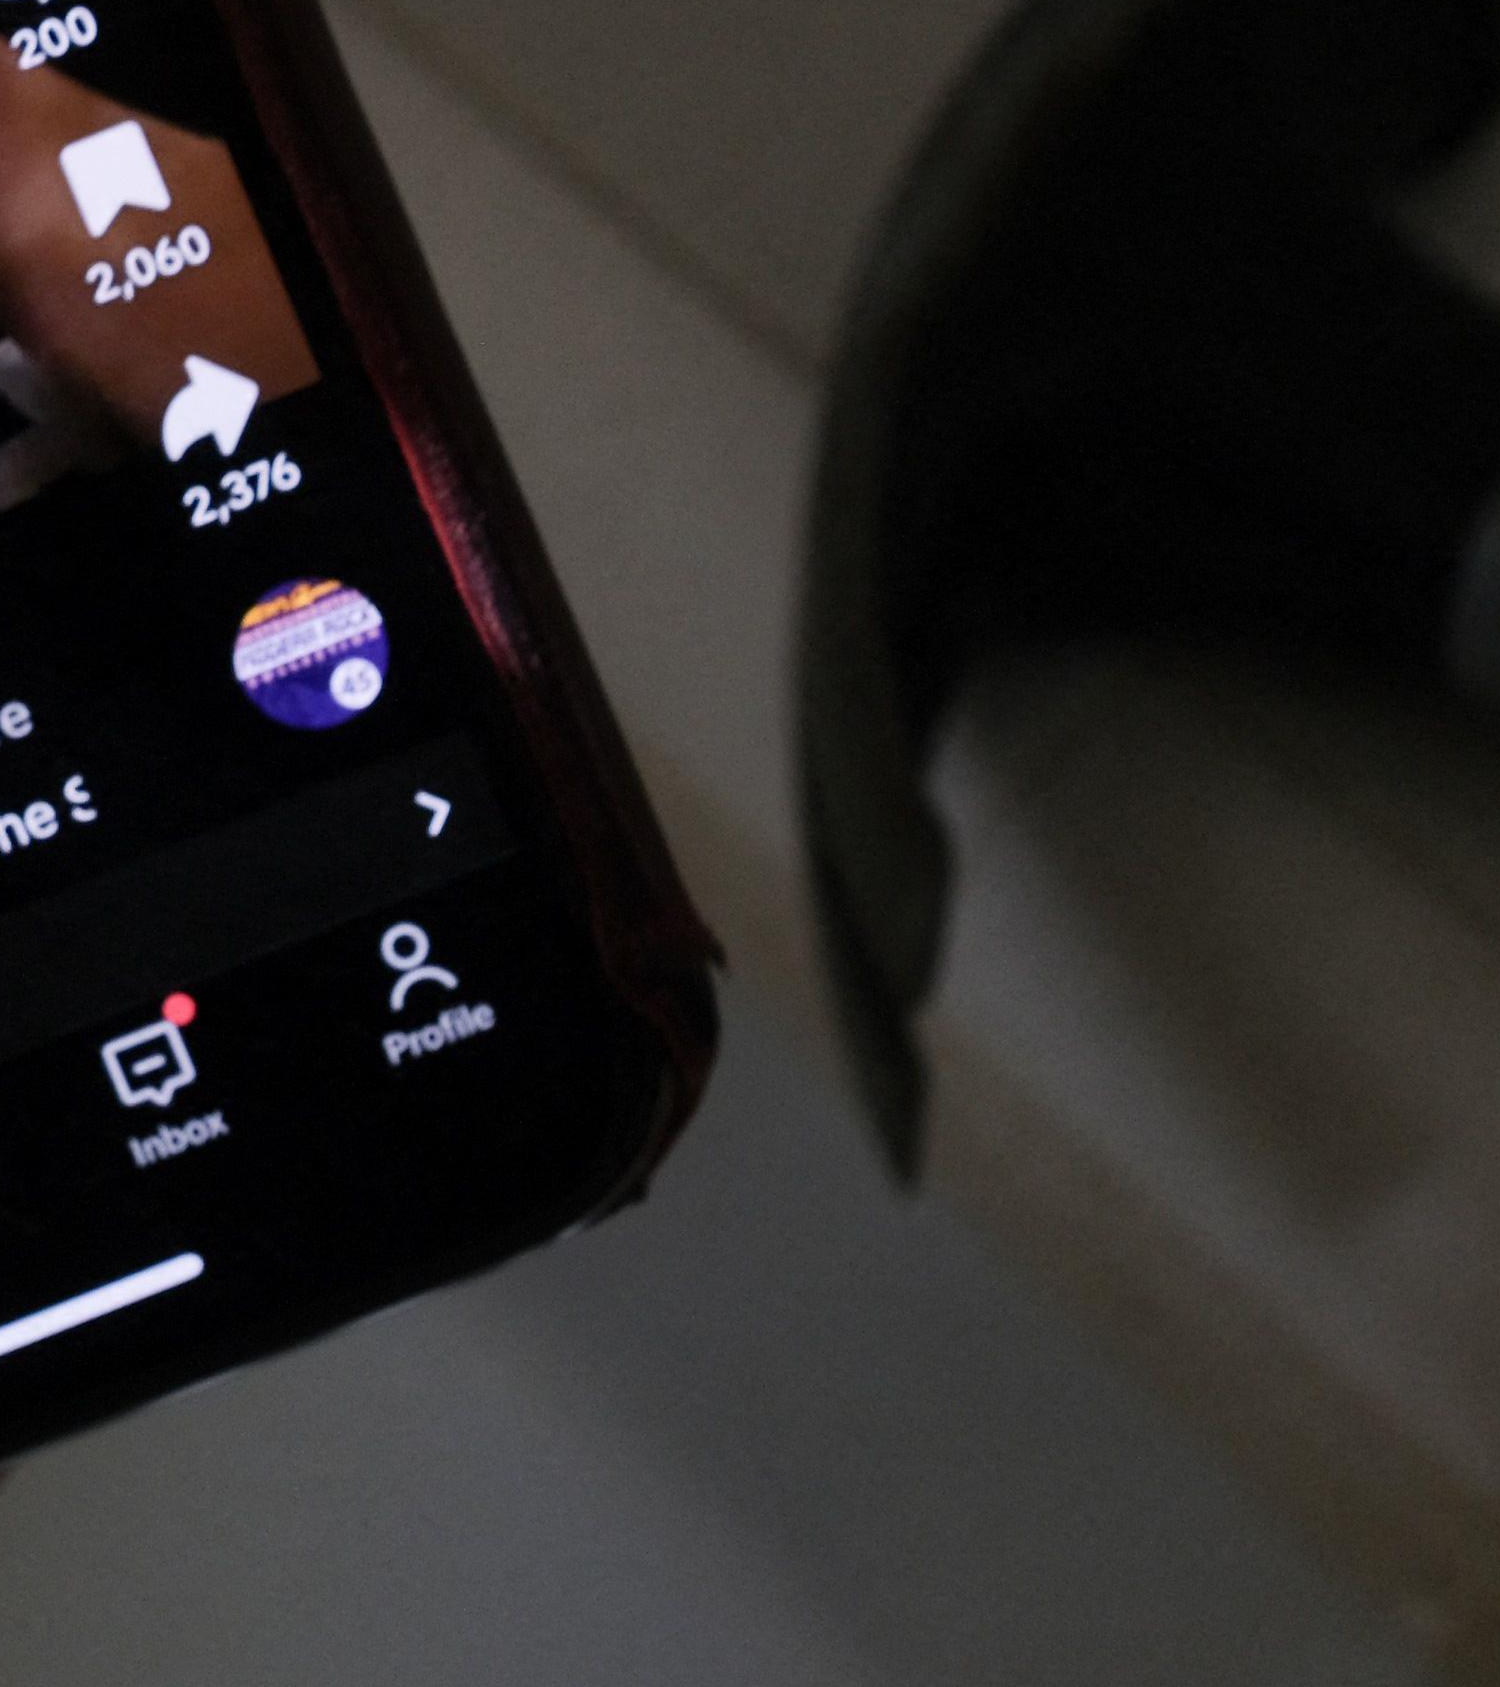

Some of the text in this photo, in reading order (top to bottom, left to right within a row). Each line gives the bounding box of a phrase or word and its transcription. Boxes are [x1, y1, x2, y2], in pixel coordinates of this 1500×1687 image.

[10, 6, 98, 71] 200
[84, 224, 211, 305] 2,060
[181, 451, 302, 528] 2,376
[381, 1002, 496, 1066] Profile
[127, 1110, 230, 1168] Inbox
